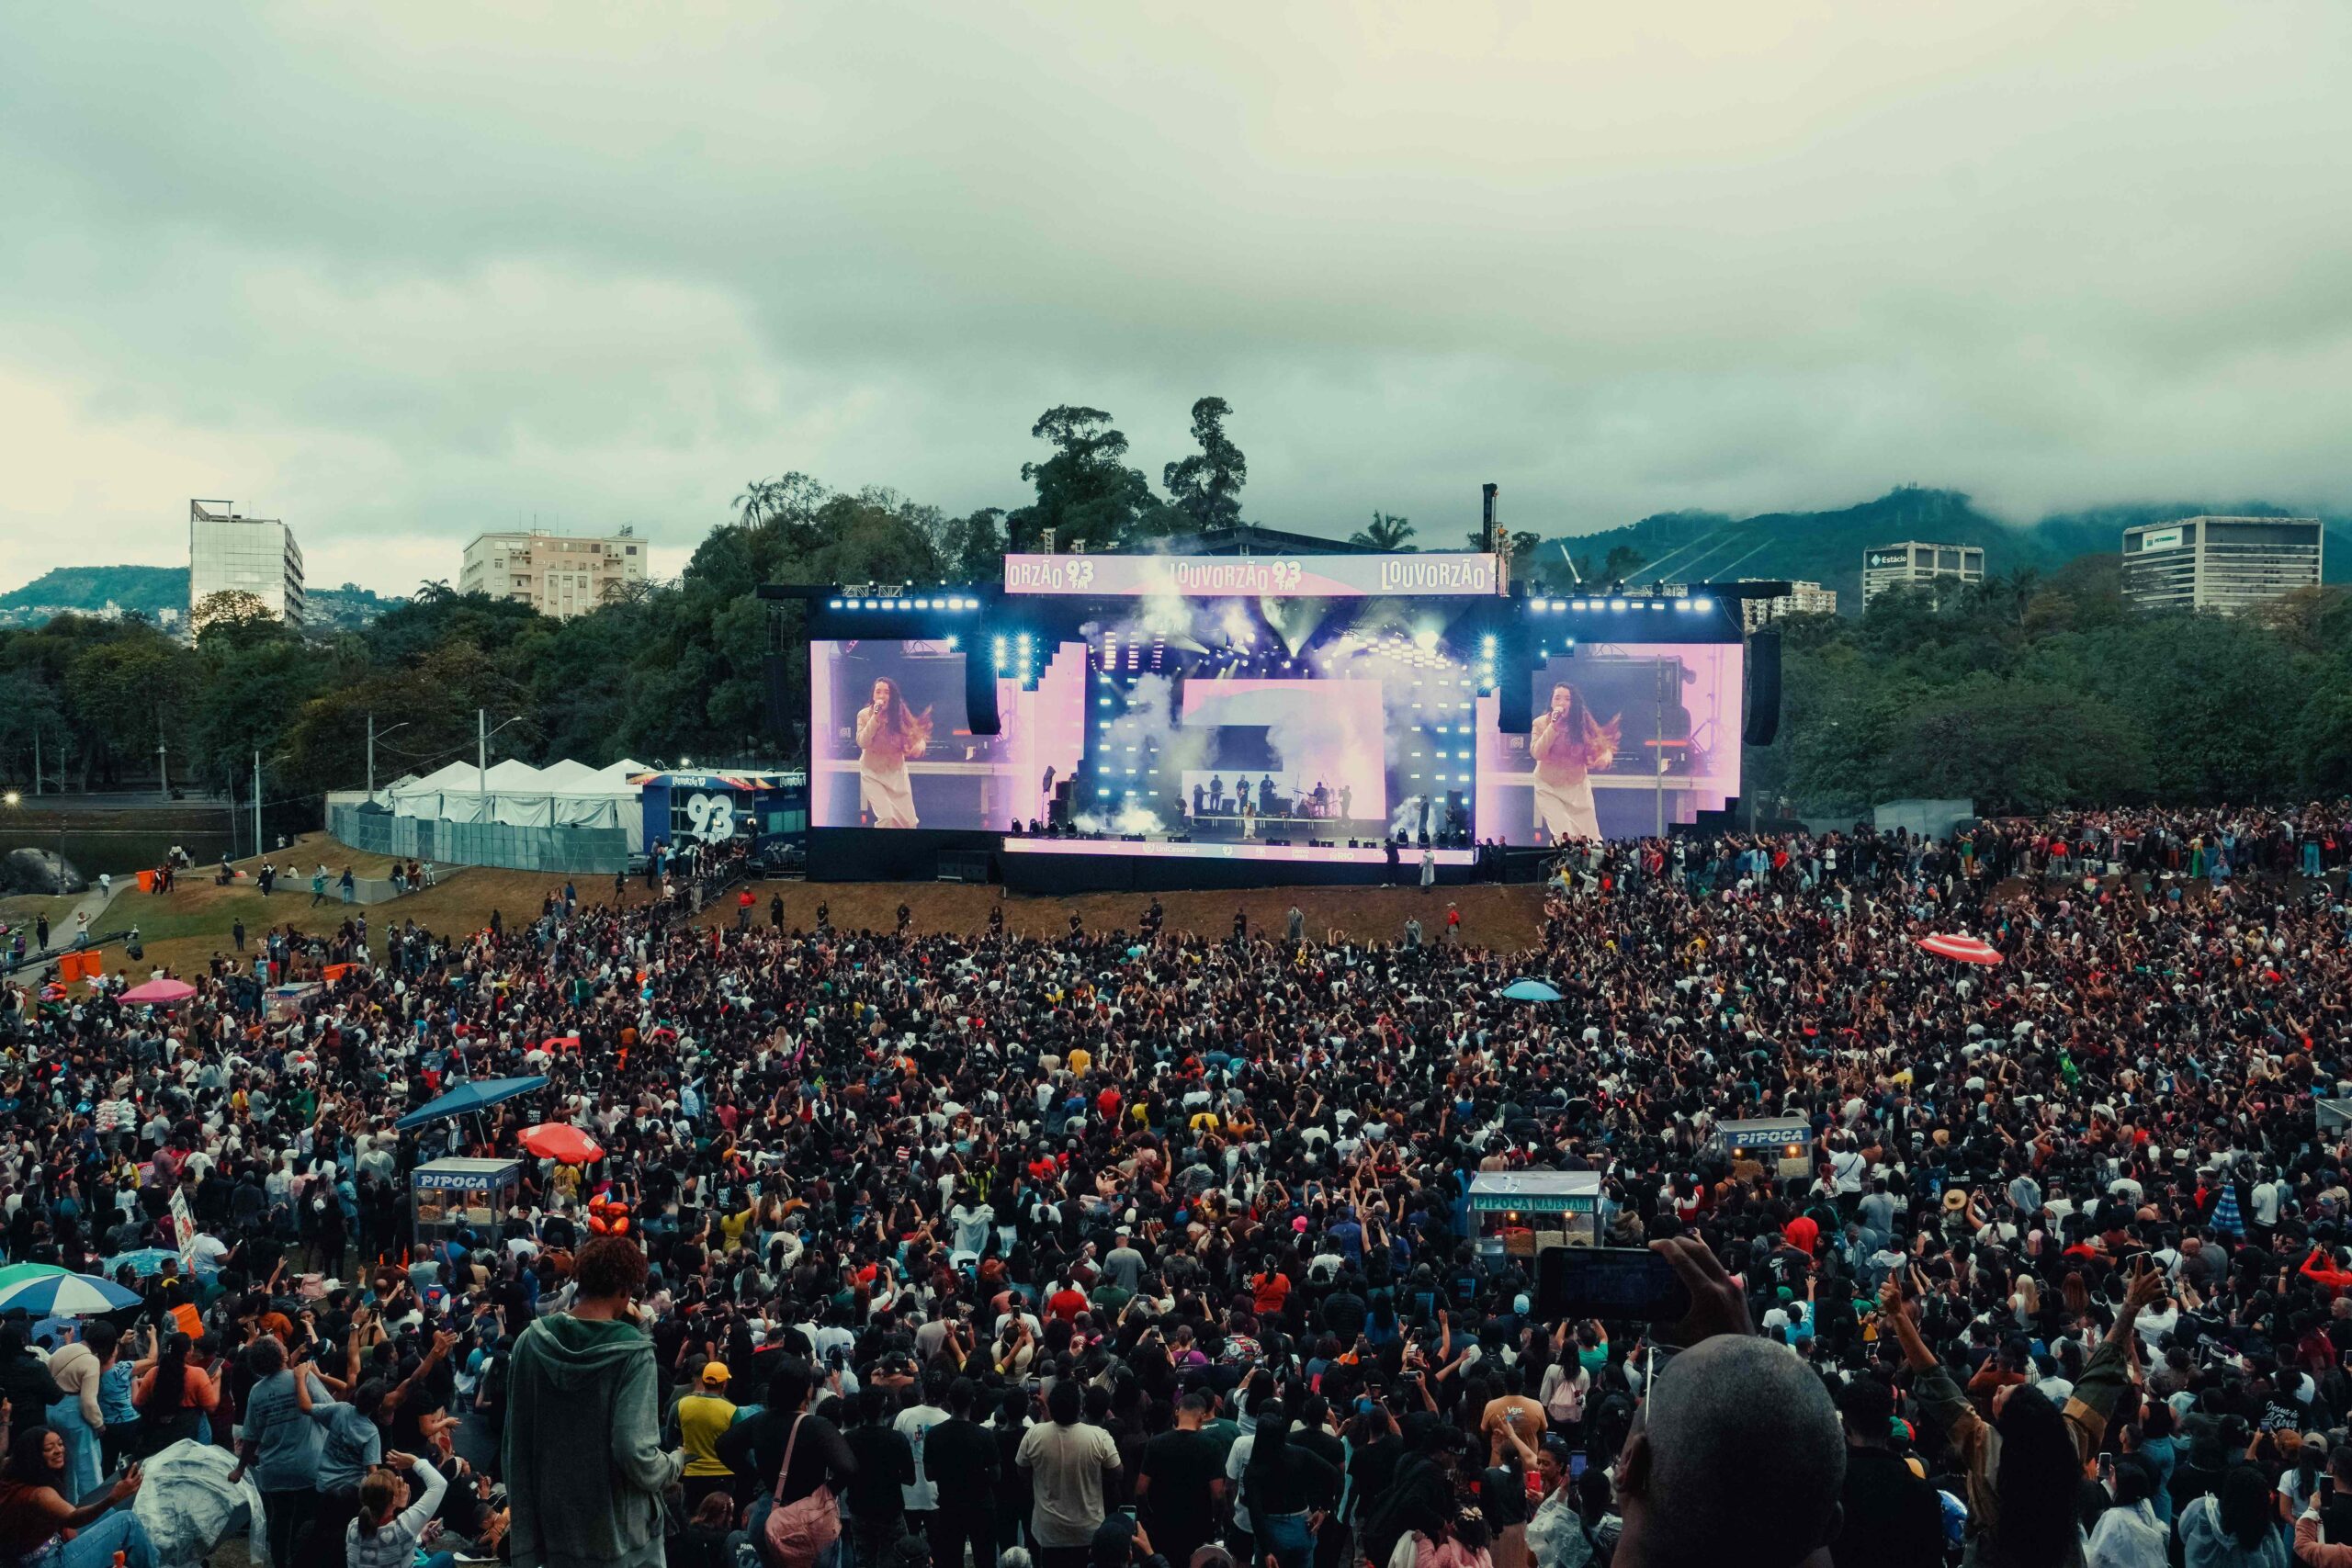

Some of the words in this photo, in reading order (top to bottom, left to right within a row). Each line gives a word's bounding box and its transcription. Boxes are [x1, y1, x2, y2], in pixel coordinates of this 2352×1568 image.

[1882, 555, 1907, 563] Estácio
[1065, 559, 1094, 583] 93
[1272, 560, 1302, 584] 93
[1381, 558, 1485, 591] LOUVORZÃO
[1071, 578, 1089, 590] FM
[1278, 580, 1295, 591] FM
[687, 793, 734, 840] 93
[1156, 844, 1198, 854] UniCesumar
[1736, 1130, 1804, 1145] PIPOCA
[421, 1175, 488, 1189] PIPOCA
[1476, 1197, 1531, 1210] PIPOCA
[1535, 1198, 1591, 1211] MAJESTADE
